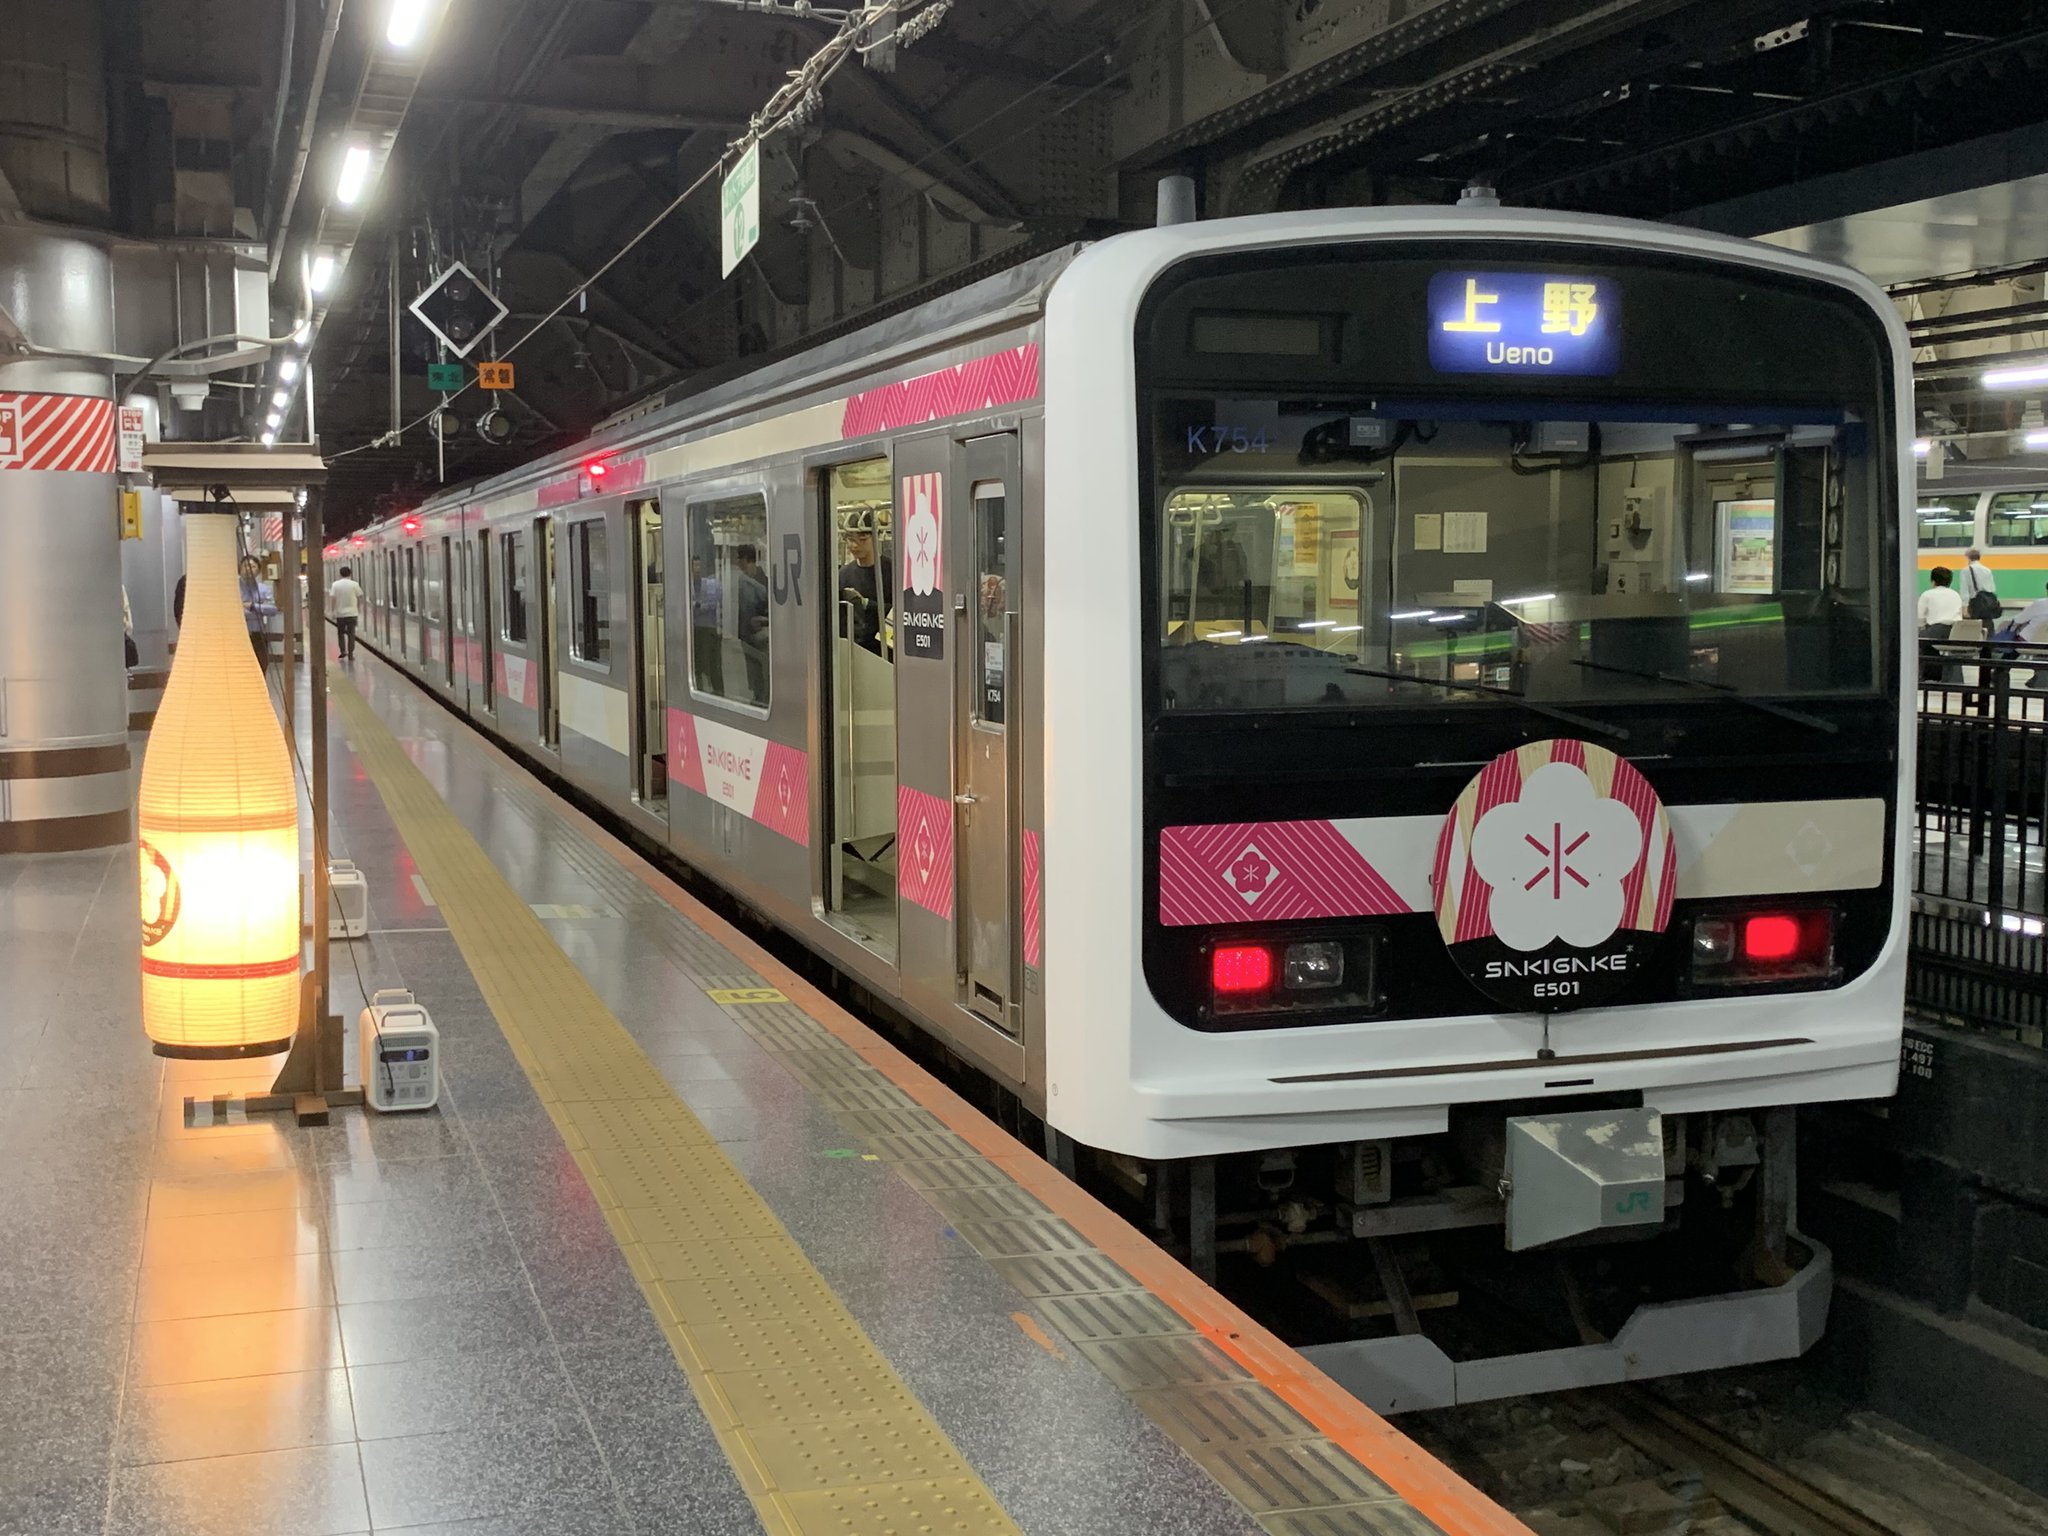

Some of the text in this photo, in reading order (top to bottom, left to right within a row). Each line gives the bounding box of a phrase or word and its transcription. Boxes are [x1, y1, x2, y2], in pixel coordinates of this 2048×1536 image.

[1443, 279, 1597, 336] 上野
[1487, 342, 1553, 365] Ueno
[1187, 426, 1269, 454] K754
[773, 534, 802, 606] JR
[916, 634, 931, 648] E501
[1485, 954, 1627, 978] SAKIGAKE
[1534, 981, 1580, 997] E501
[1615, 1191, 1650, 1215] JR
